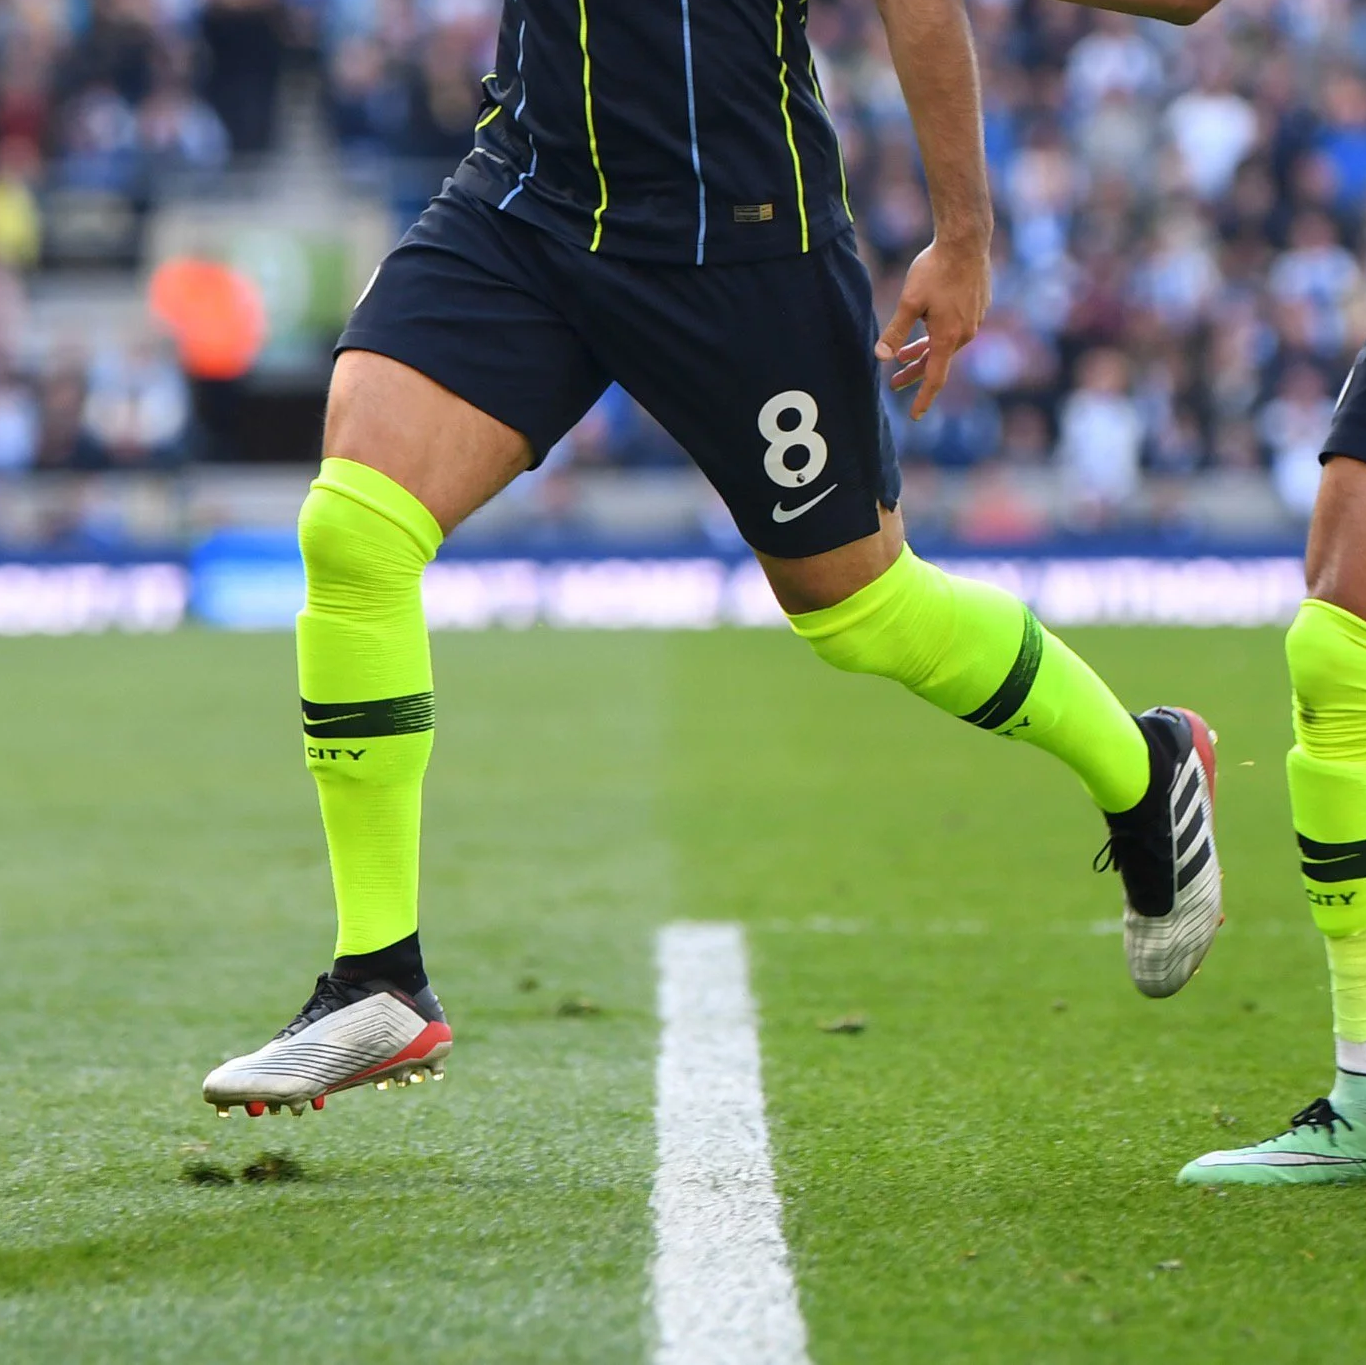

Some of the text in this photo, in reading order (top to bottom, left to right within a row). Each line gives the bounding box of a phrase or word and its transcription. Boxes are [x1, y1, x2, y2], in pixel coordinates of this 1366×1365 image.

[757, 389, 828, 488] 8
[307, 747, 367, 761] CITY
[1305, 888, 1358, 906] CITY
